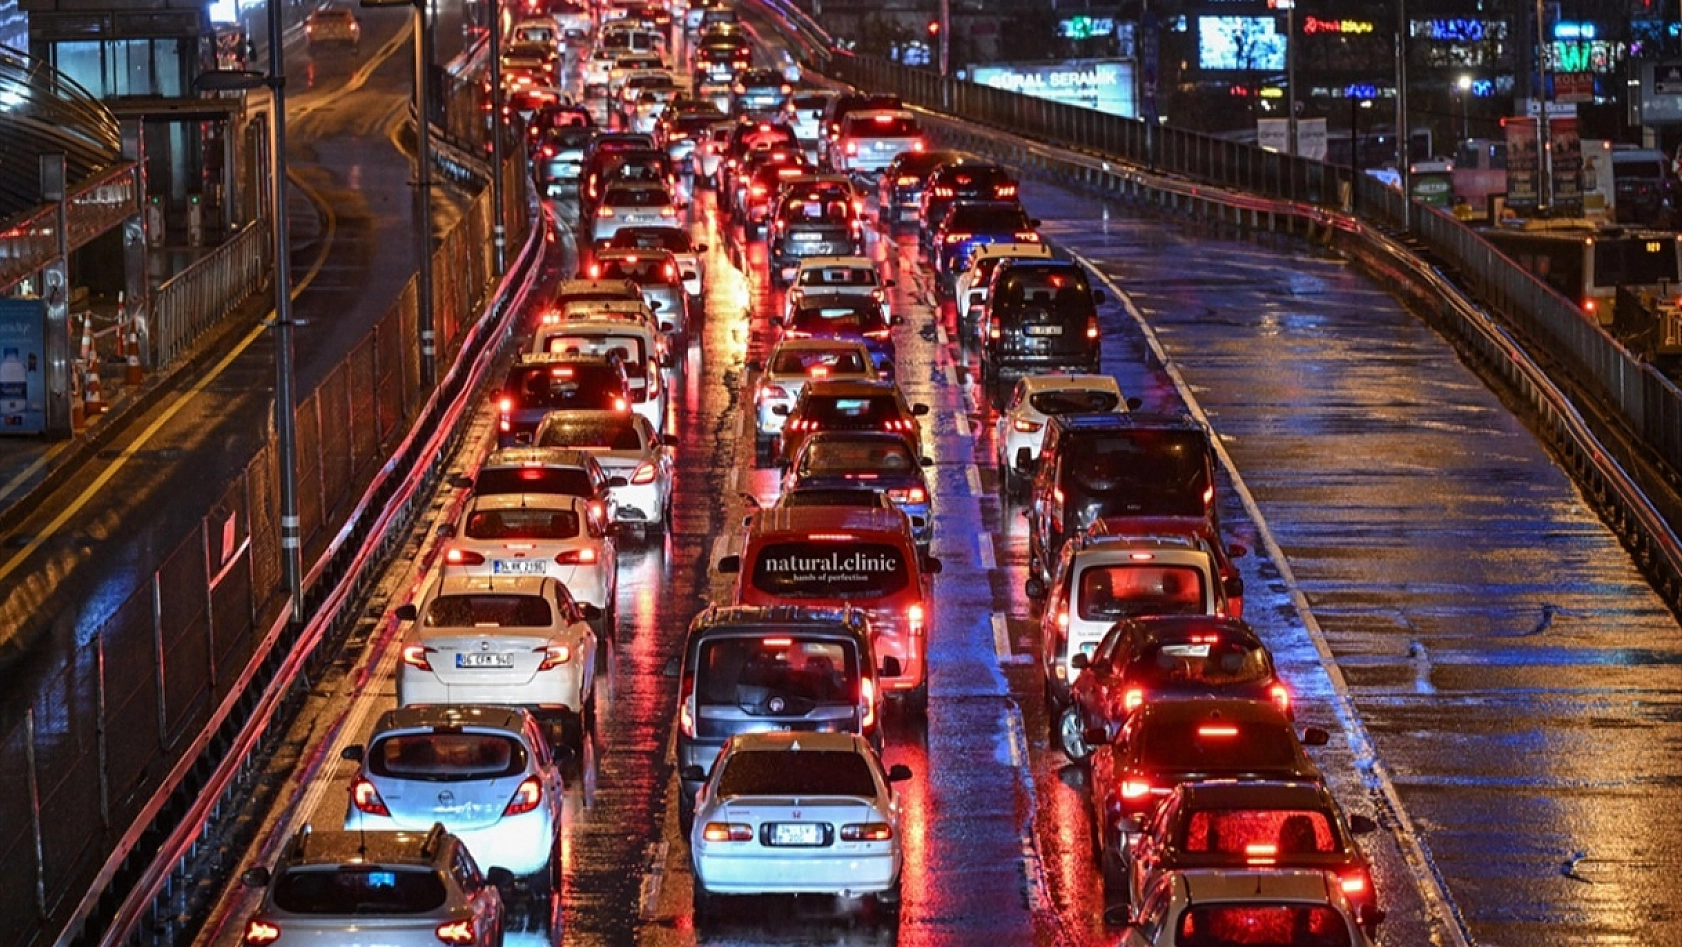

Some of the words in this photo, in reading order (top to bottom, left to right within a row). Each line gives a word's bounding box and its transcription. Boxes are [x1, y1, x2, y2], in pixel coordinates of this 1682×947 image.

[764, 551, 896, 571] natural.clinic
[793, 572, 816, 581] hands
[818, 572, 826, 581] of
[828, 572, 869, 583] perfection
